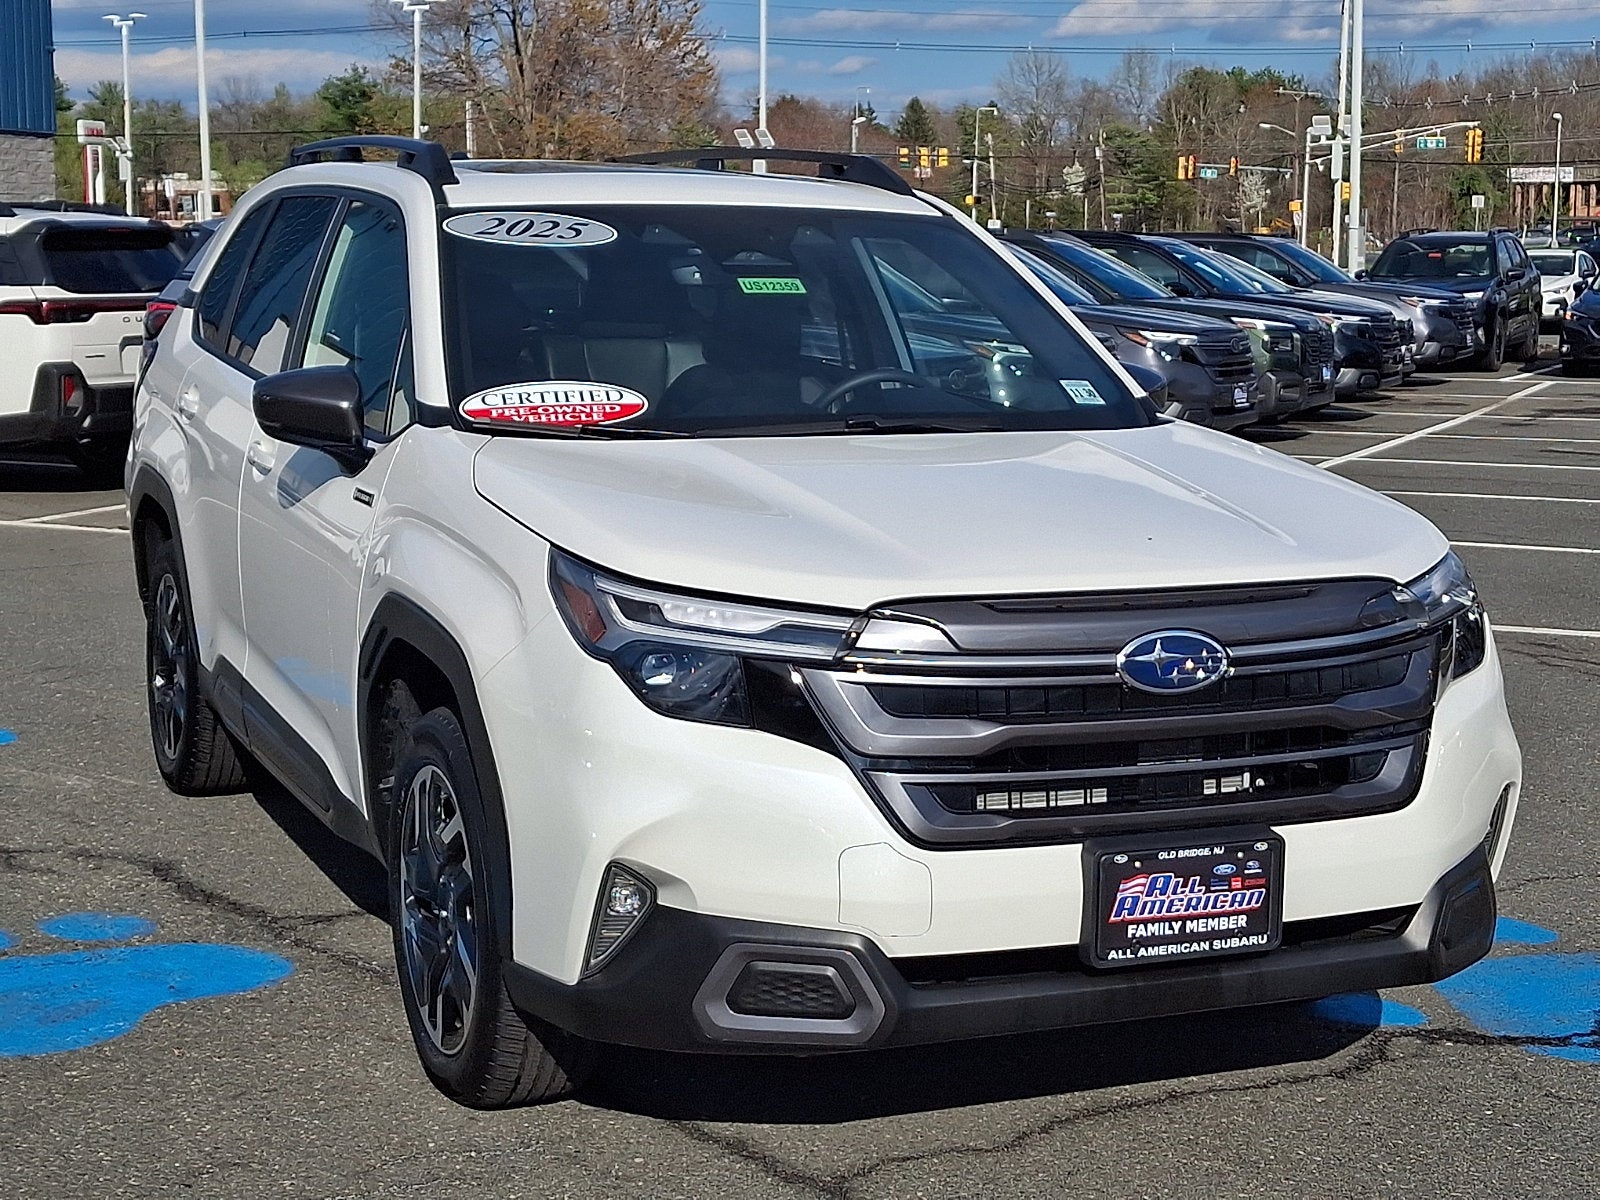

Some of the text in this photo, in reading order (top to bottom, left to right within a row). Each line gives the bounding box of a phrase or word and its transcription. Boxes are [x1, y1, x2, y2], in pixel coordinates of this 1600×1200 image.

[474, 217, 590, 240] 2025
[742, 281, 800, 291] US12359
[481, 389, 624, 407] CERTIFIED
[490, 404, 622, 417] PRE-OWNED
[511, 412, 605, 423] VEHICLE
[1158, 851, 1177, 860] OLD
[1213, 846, 1225, 855] NJ
[1144, 873, 1206, 898] ALL
[1112, 888, 1266, 919] AMERICAN
[1127, 915, 1247, 938] FAMILY MEMBER
[1107, 934, 1268, 960] ALL AMERICAN SUBARU
